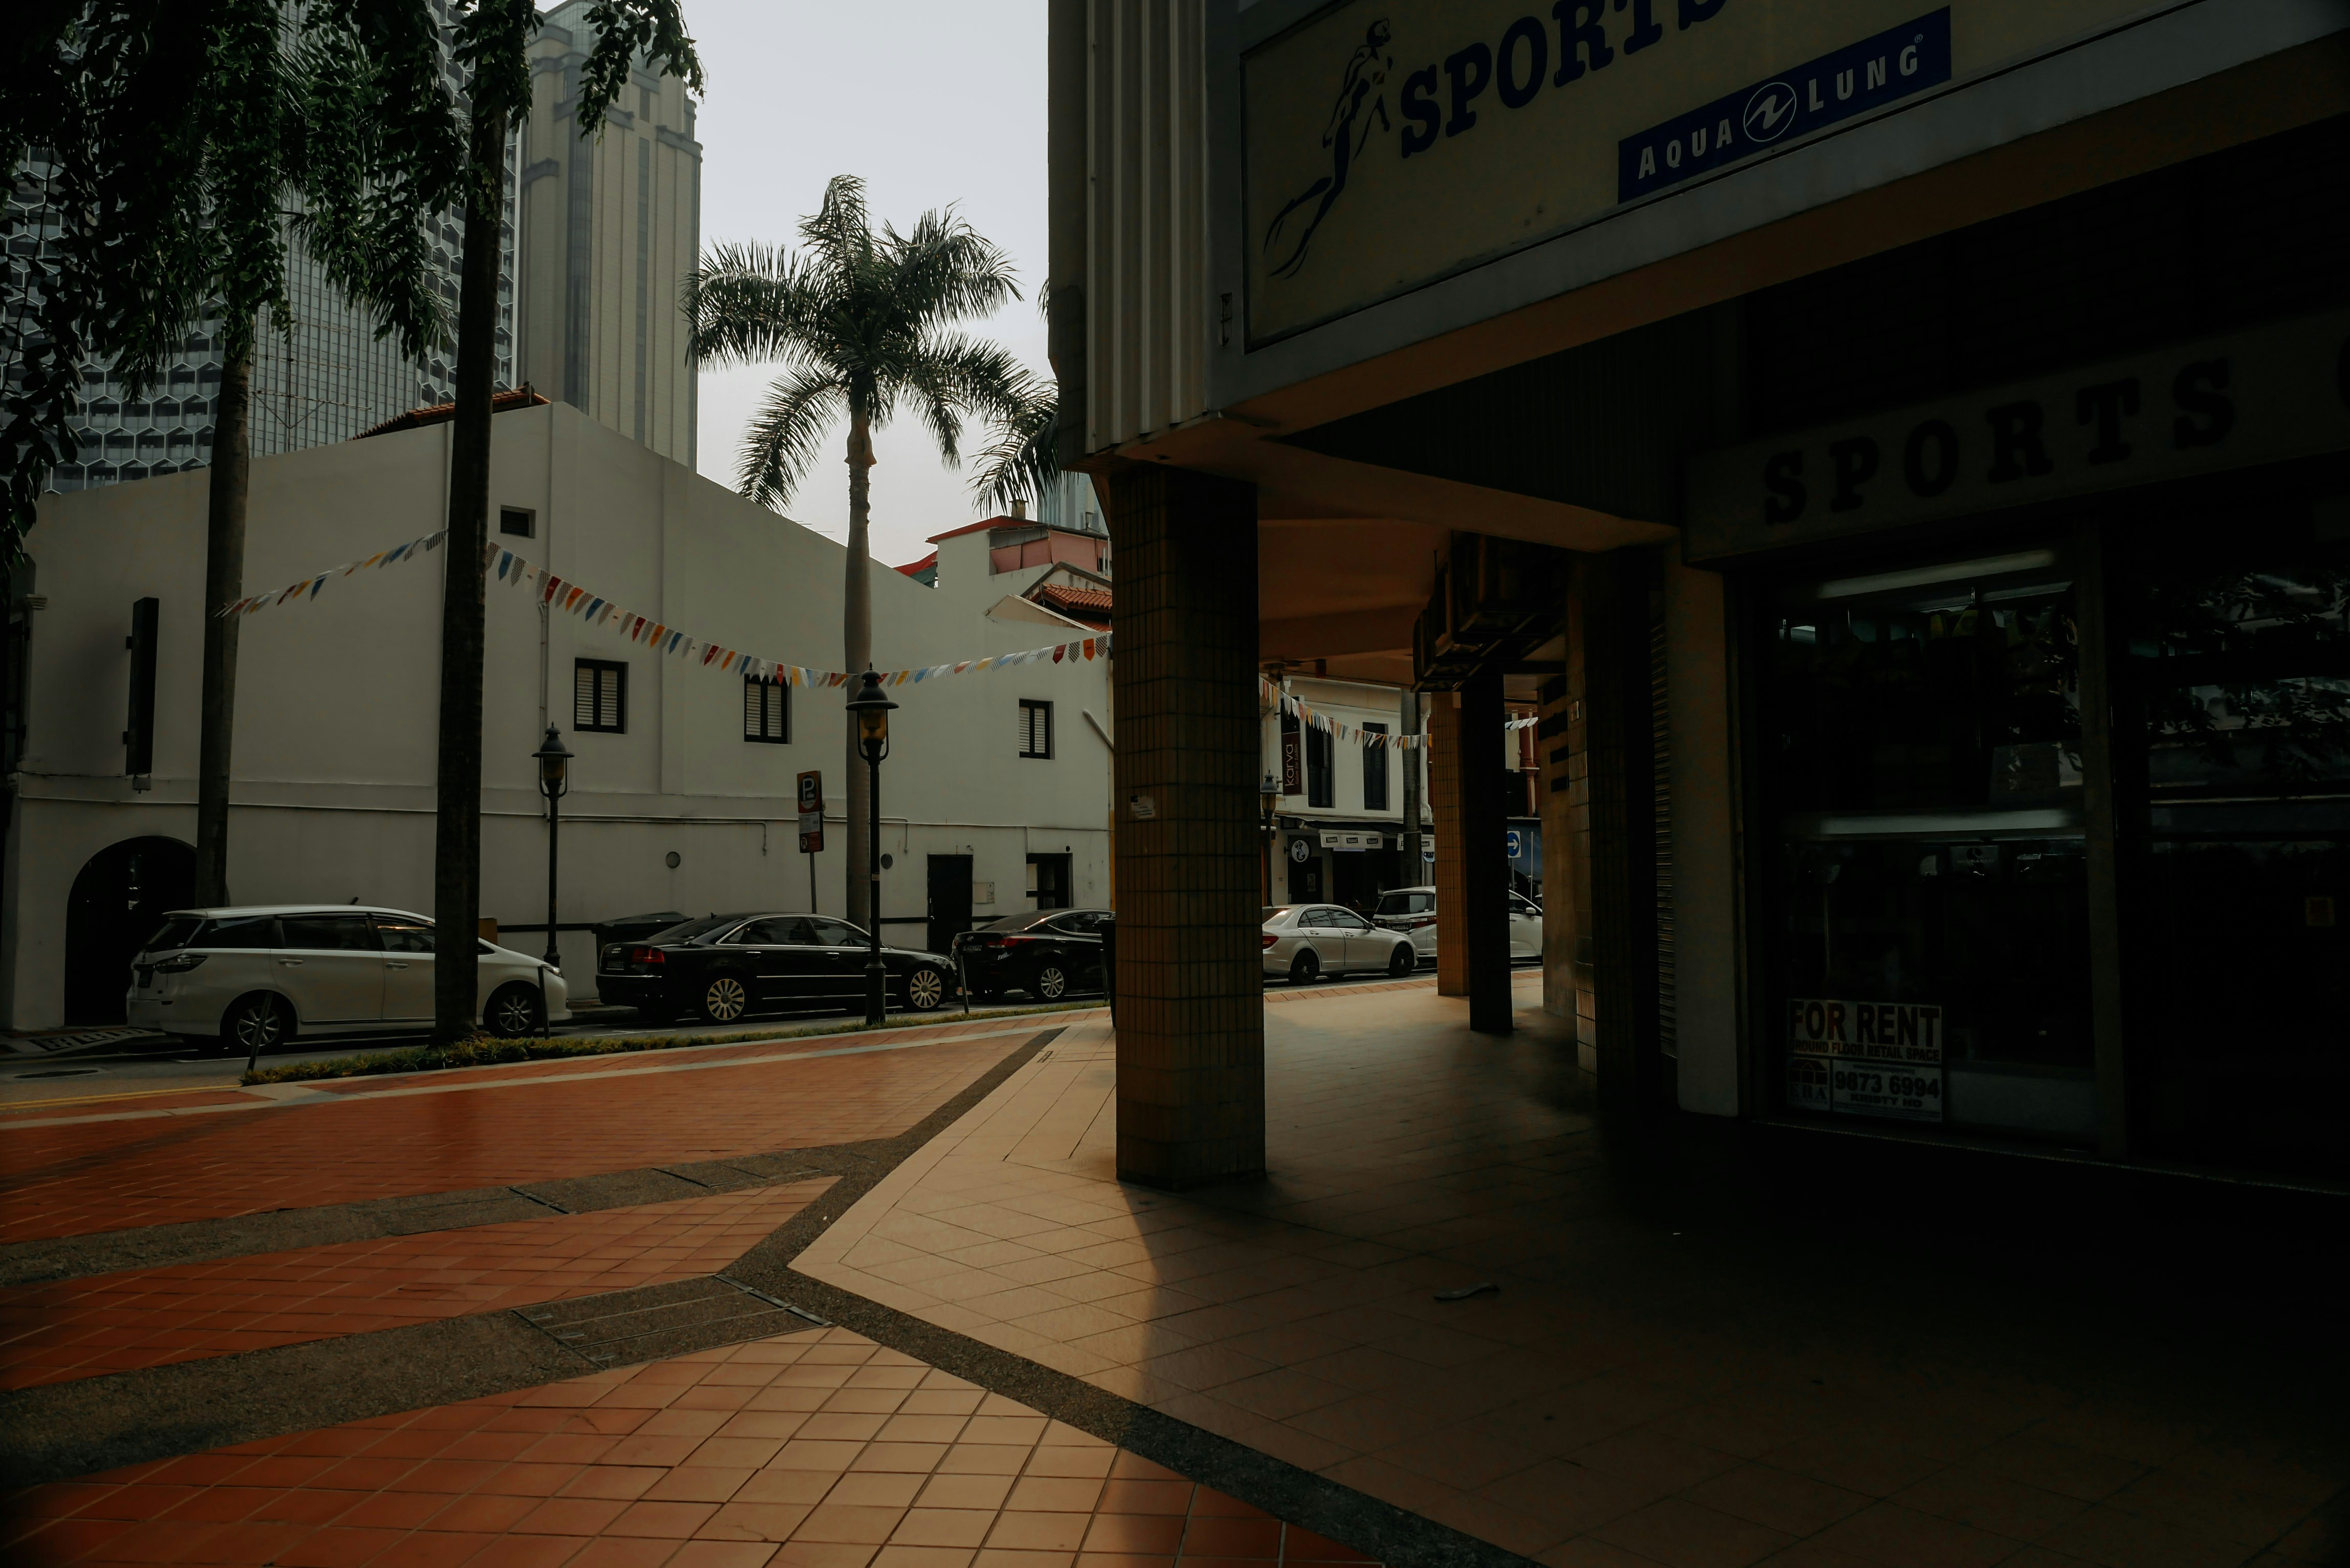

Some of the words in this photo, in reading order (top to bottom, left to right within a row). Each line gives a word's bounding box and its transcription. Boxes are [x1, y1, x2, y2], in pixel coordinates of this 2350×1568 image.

[1638, 118, 1733, 180] AQUA
[1765, 358, 2234, 526] SPORTS
[1285, 744, 1295, 786] karva
[802, 777, 815, 801] P
[1789, 1000, 1847, 1041] FOR
[1856, 1004, 1940, 1047] RENT
[1788, 1039, 1829, 1053] GROUND
[1832, 1041, 1864, 1056] FLOOR
[1867, 1045, 1903, 1059] RETAIL
[1906, 1047, 1940, 1061] SPACE
[1789, 1083, 1826, 1099] ERA
[1835, 1070, 1883, 1094] 9873
[1889, 1075, 1940, 1099] 6994
